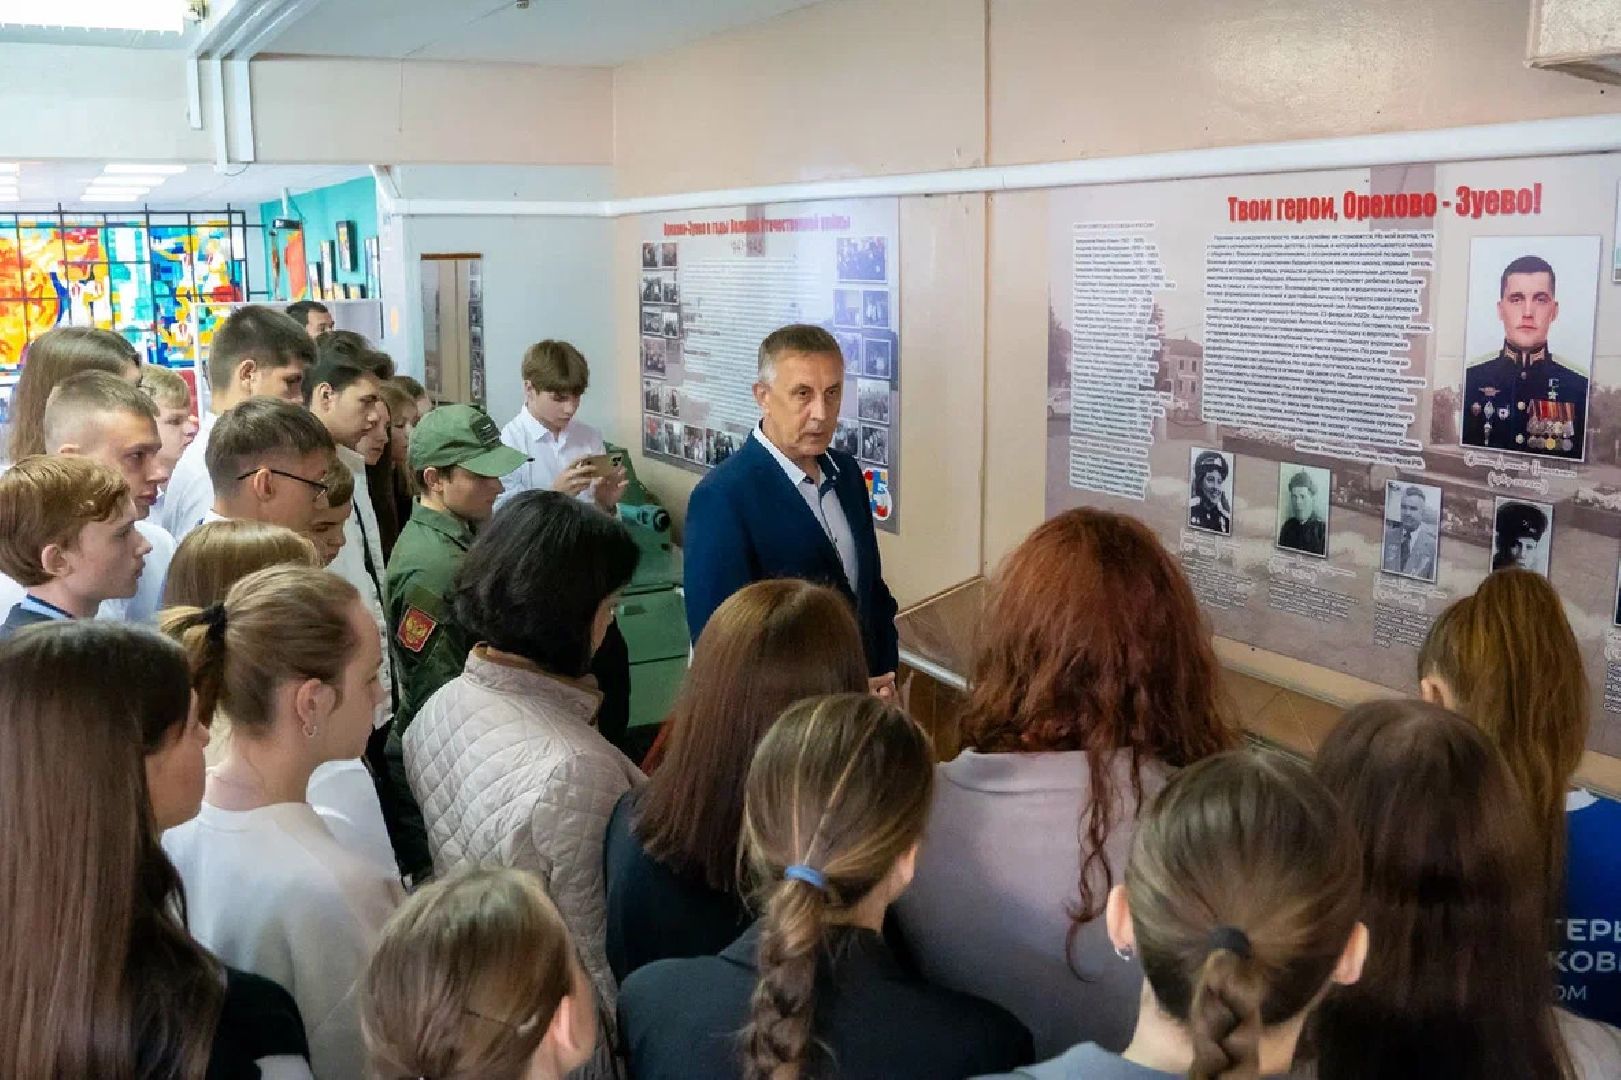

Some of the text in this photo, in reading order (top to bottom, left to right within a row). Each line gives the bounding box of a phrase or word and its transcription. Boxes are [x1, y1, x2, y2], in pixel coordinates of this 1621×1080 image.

[1228, 197, 1272, 222] Твои
[1276, 196, 1338, 224] герои,
[1343, 190, 1437, 222] Орехово
[1455, 183, 1543, 220] Зуево!
